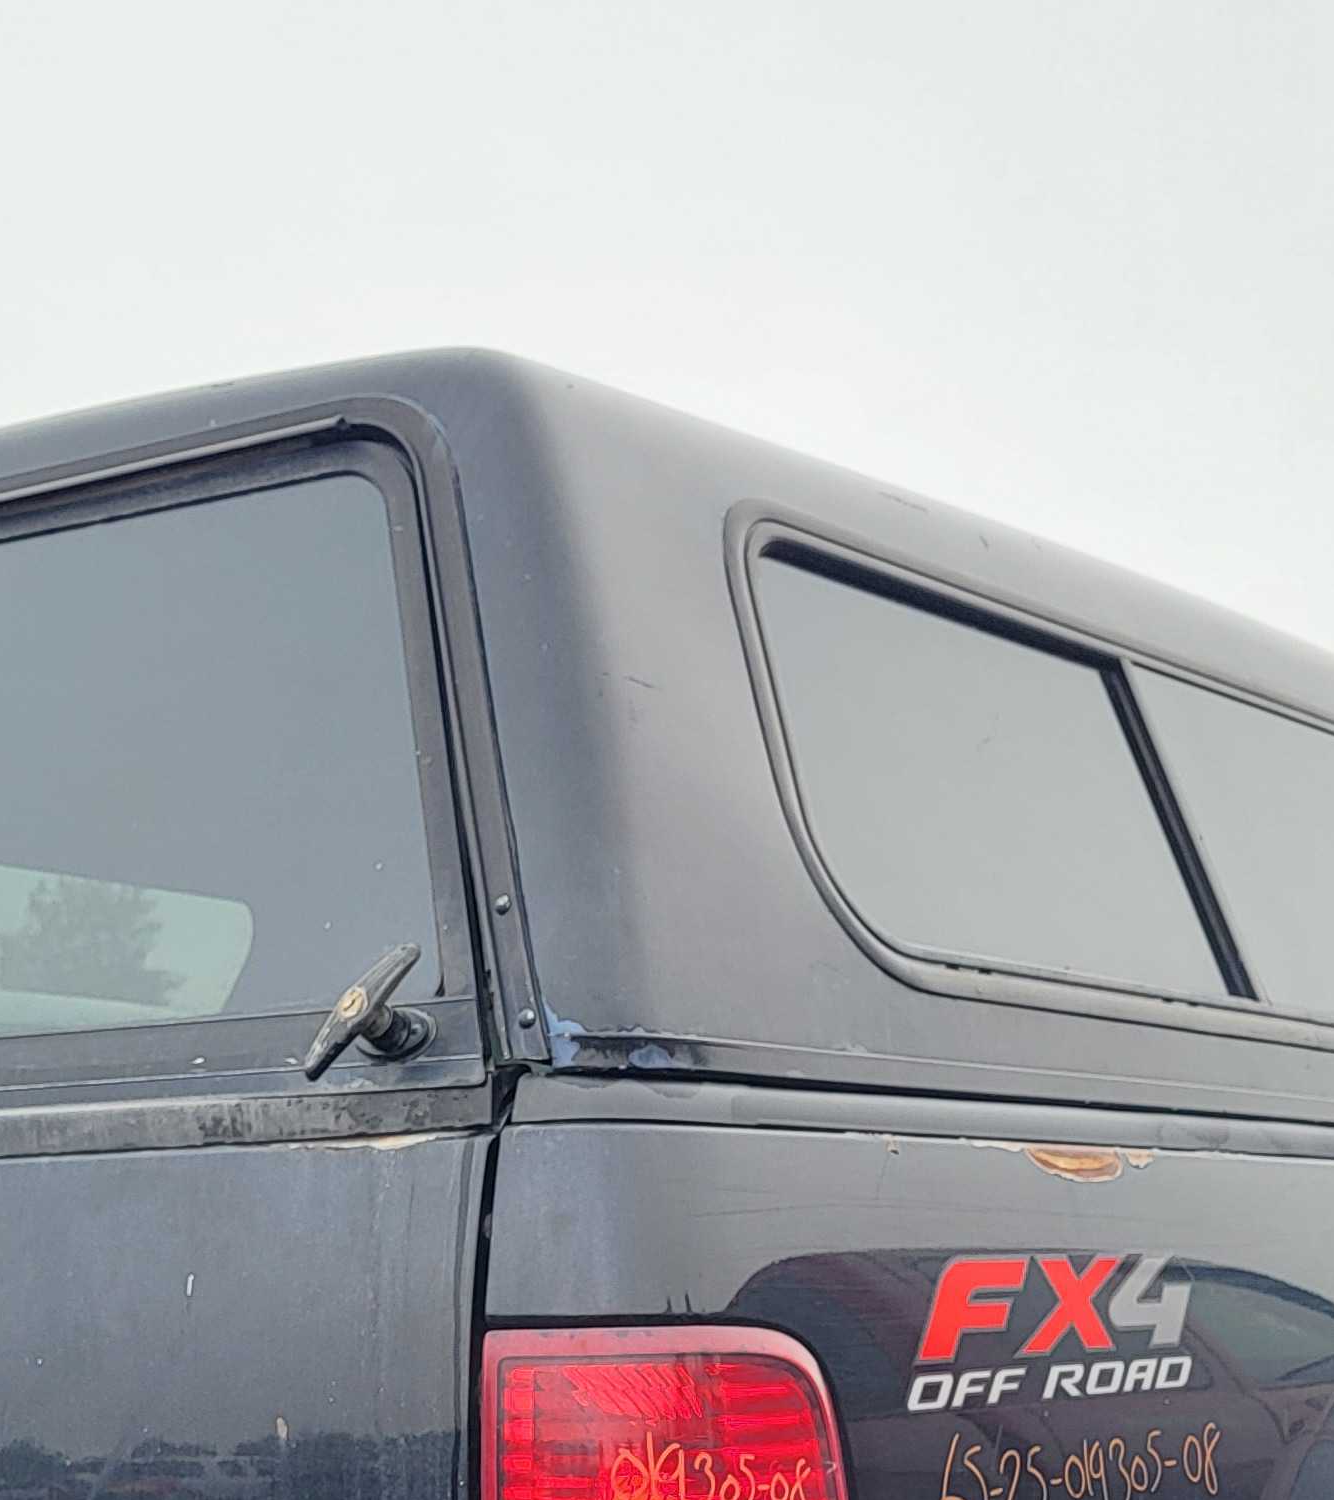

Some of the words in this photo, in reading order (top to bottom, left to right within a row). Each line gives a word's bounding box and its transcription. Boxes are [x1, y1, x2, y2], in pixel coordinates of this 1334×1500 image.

[915, 1253, 1194, 1365] FX4
[906, 1364, 1028, 1413] OFF
[1041, 1355, 1193, 1401] ROAD
